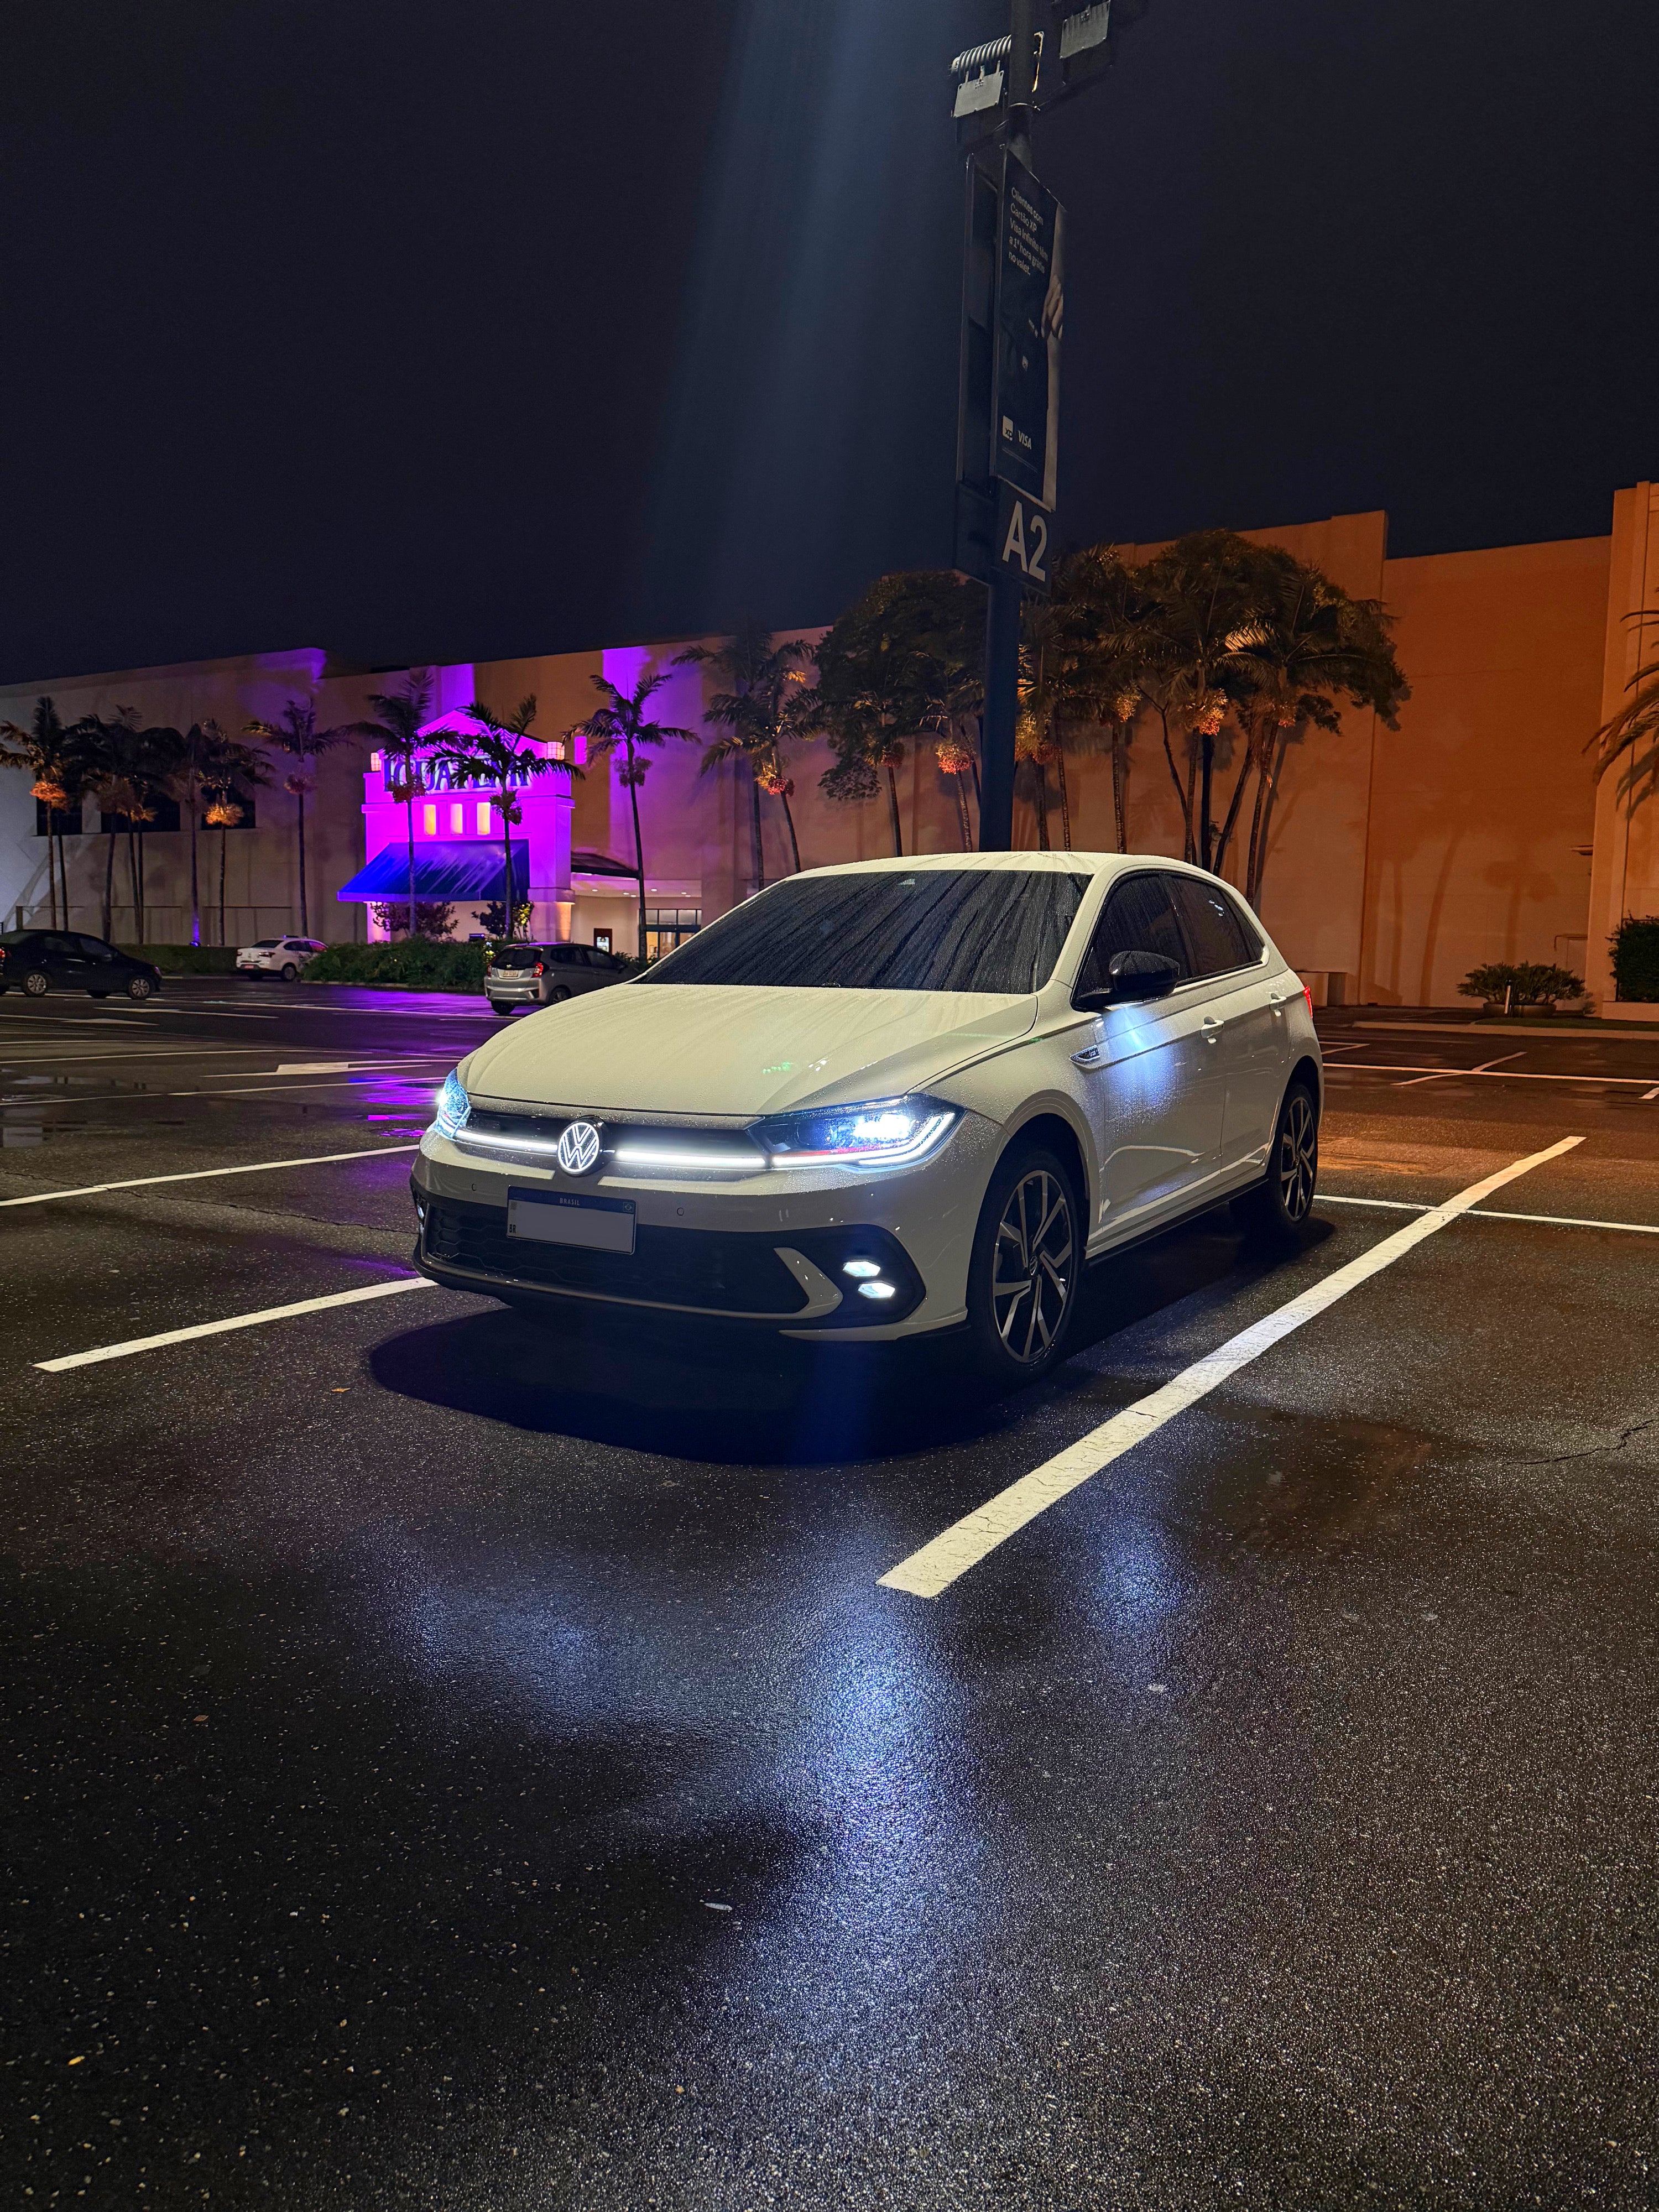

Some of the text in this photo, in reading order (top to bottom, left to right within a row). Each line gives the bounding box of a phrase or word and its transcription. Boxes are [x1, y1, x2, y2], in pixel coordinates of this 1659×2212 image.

[1011, 187, 1033, 215] Clientes
[1010, 202, 1037, 233] Cartão XP
[1010, 217, 1021, 236] Visa
[1022, 228, 1039, 252] Infinite
[1009, 236, 1013, 245] a
[1020, 242, 1031, 261] hora
[1009, 251, 1016, 264] no
[1018, 430, 1032, 450] VISA
[1002, 500, 1047, 582] A2
[509, 1224, 516, 1234] BR
